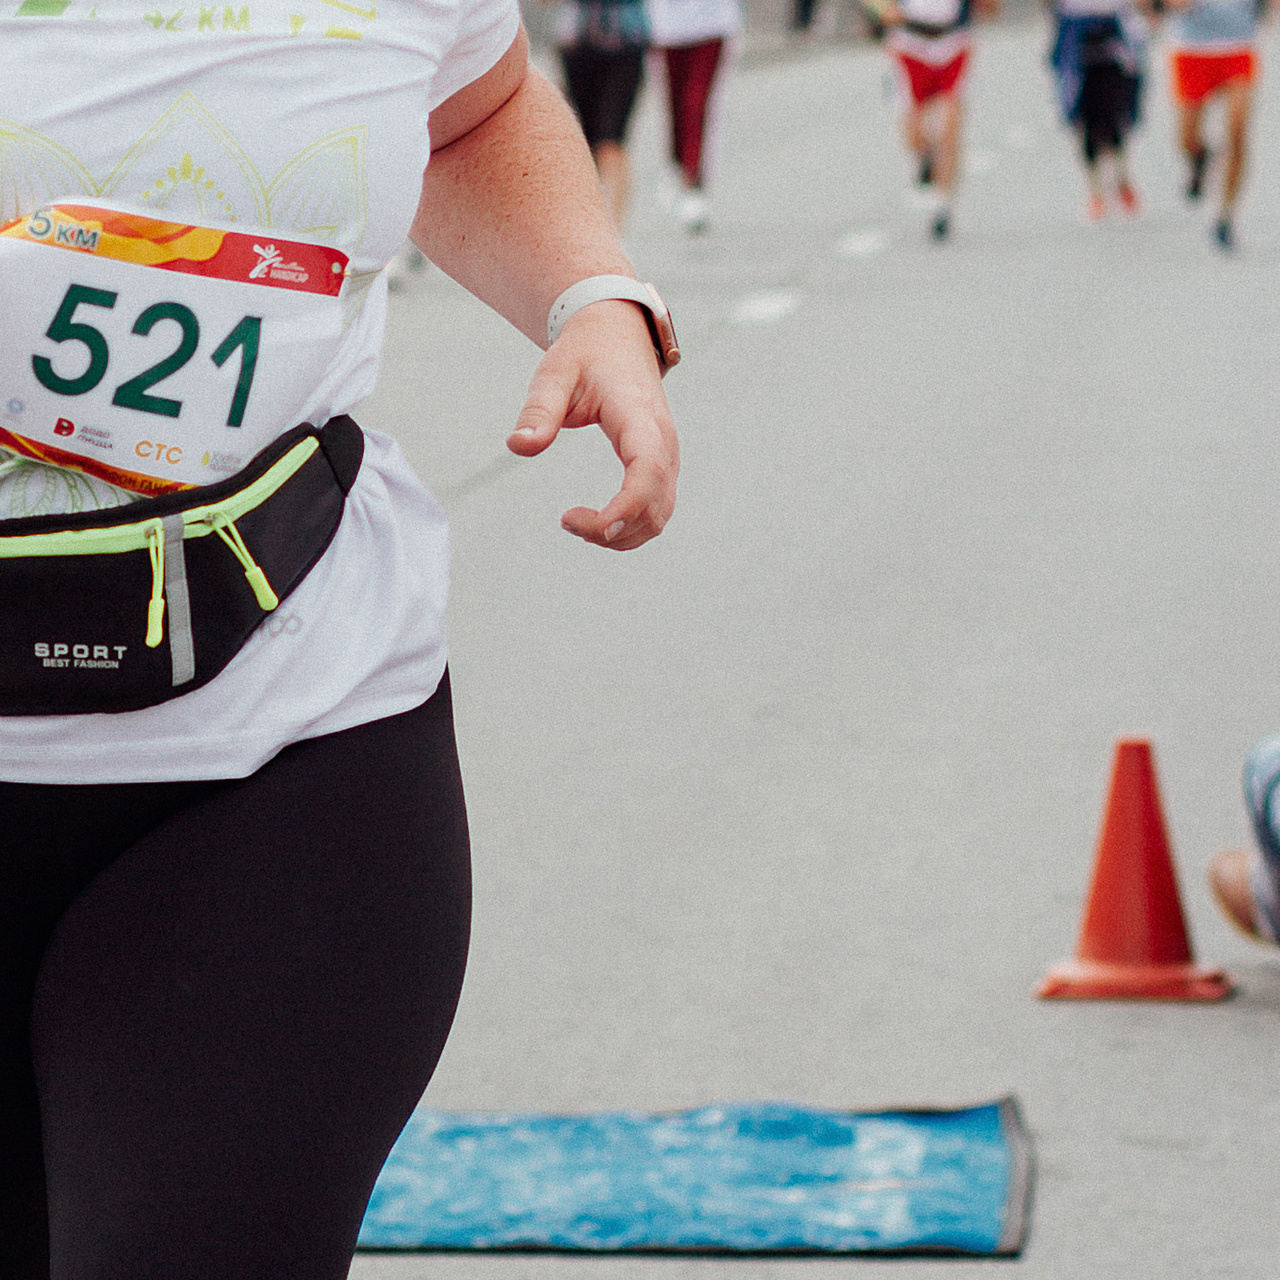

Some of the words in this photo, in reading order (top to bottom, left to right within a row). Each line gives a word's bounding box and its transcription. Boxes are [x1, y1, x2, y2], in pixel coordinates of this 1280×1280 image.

[198, 5, 250, 32] KM
[27, 204, 53, 239] 5
[31, 282, 263, 429] 521
[34, 642, 128, 660] SPORT
[43, 658, 70, 669] BEST
[73, 659, 120, 670] FASHION
